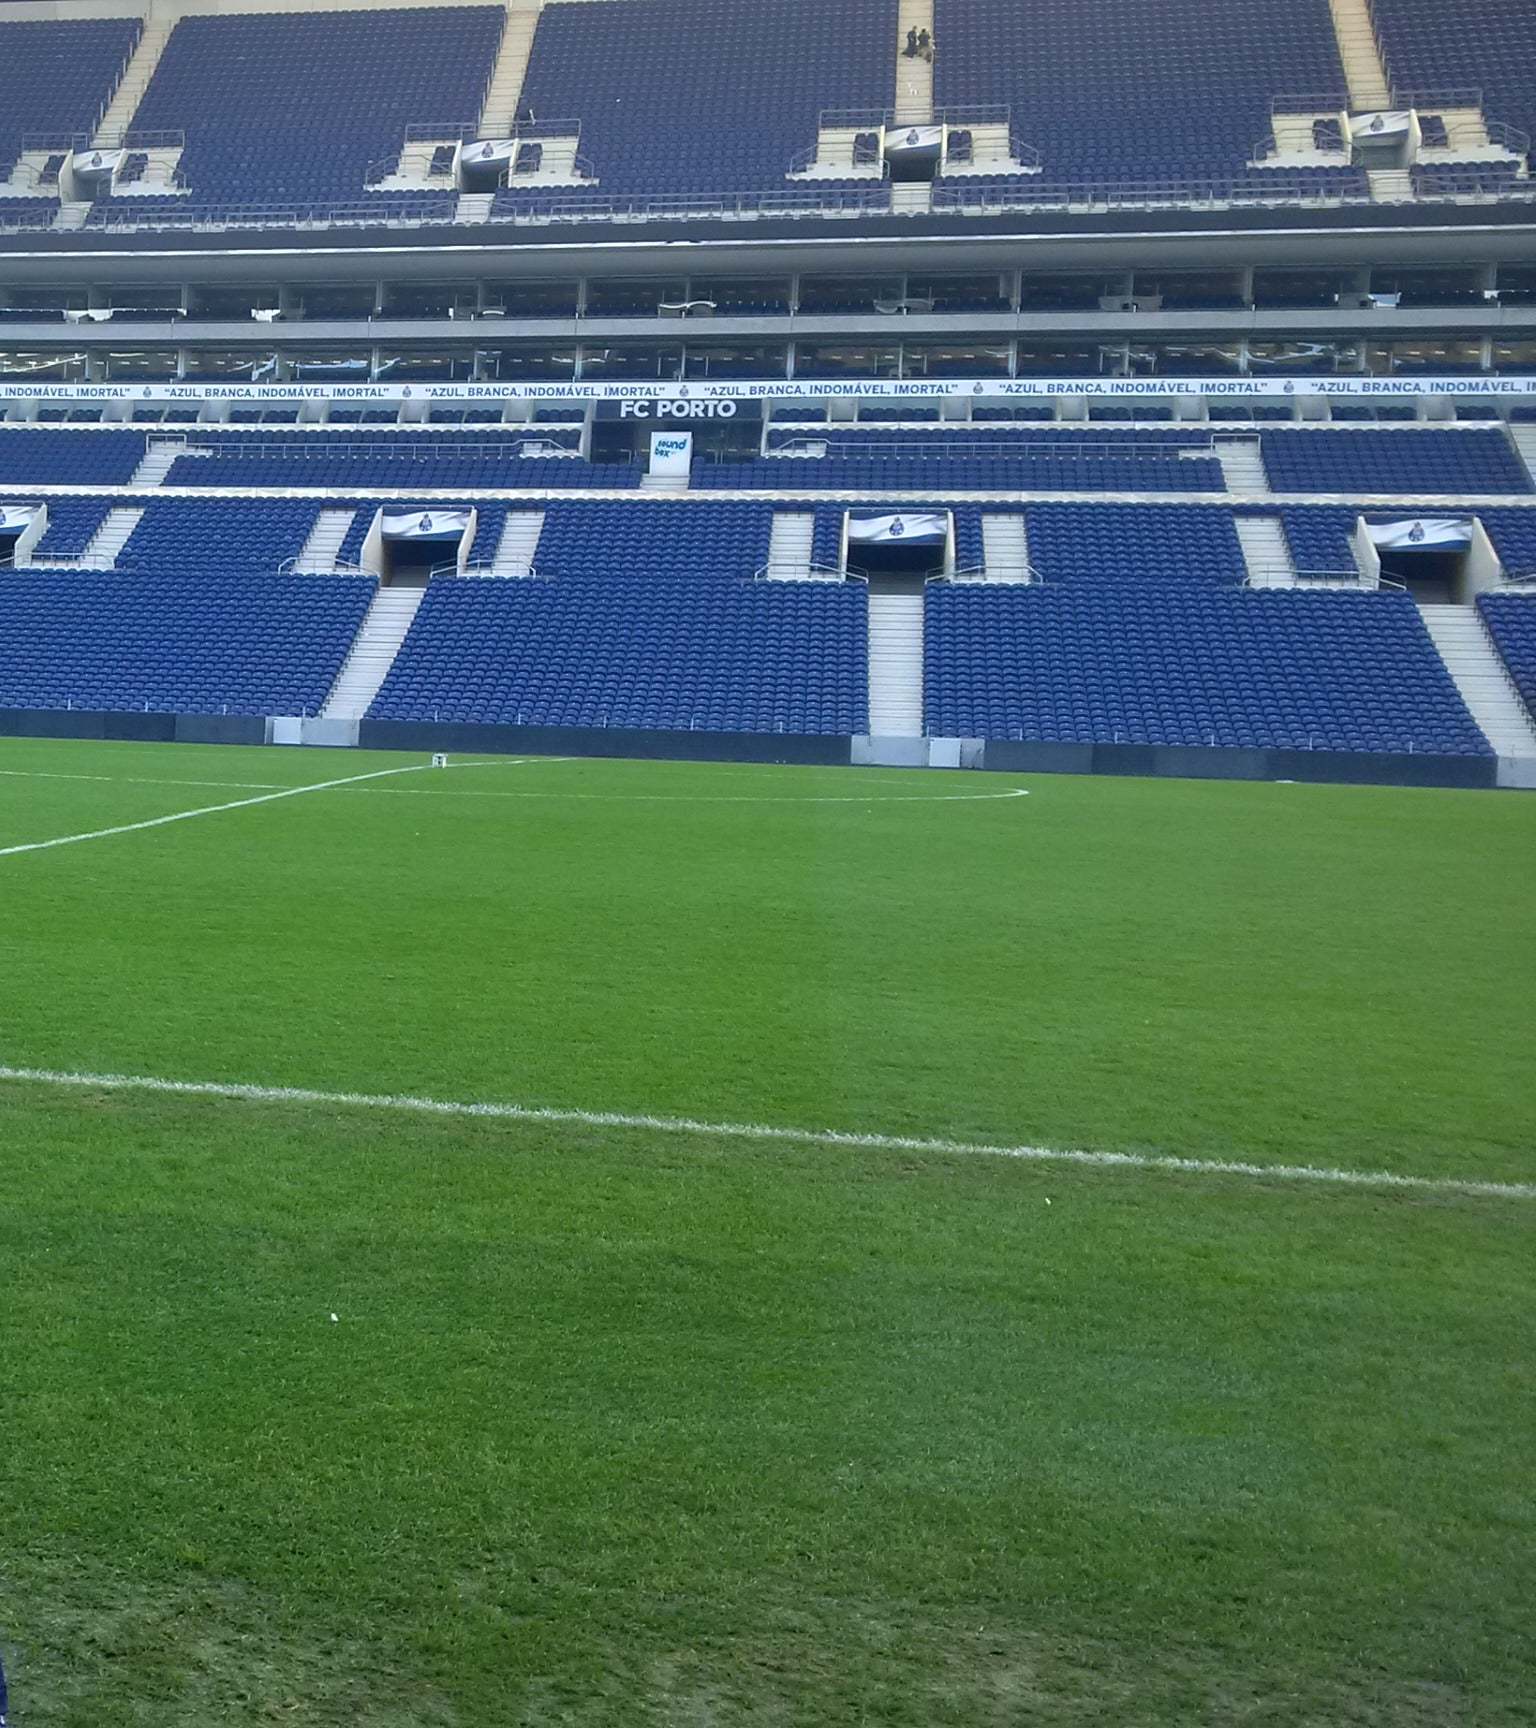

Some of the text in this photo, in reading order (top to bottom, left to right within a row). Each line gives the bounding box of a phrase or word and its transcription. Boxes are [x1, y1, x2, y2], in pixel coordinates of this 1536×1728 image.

[5, 386, 75, 397] INDOMÁVEL,
[205, 388, 256, 398] BRANCA,
[258, 387, 331, 398] INDOMÁVEL,
[467, 387, 522, 397] BRANCA,
[524, 385, 602, 397] INDOMÁVEL,
[749, 385, 807, 396] BRANCA,
[809, 383, 891, 395] INDOMÁVEL,
[1047, 383, 1107, 394] BRANCA,
[1110, 381, 1197, 393] INDOMÁVEL,
[1362, 382, 1427, 393] BRANCA,
[1430, 380, 1523, 393] INDOMÁVEL,
[620, 400, 737, 418] FC PORTO
